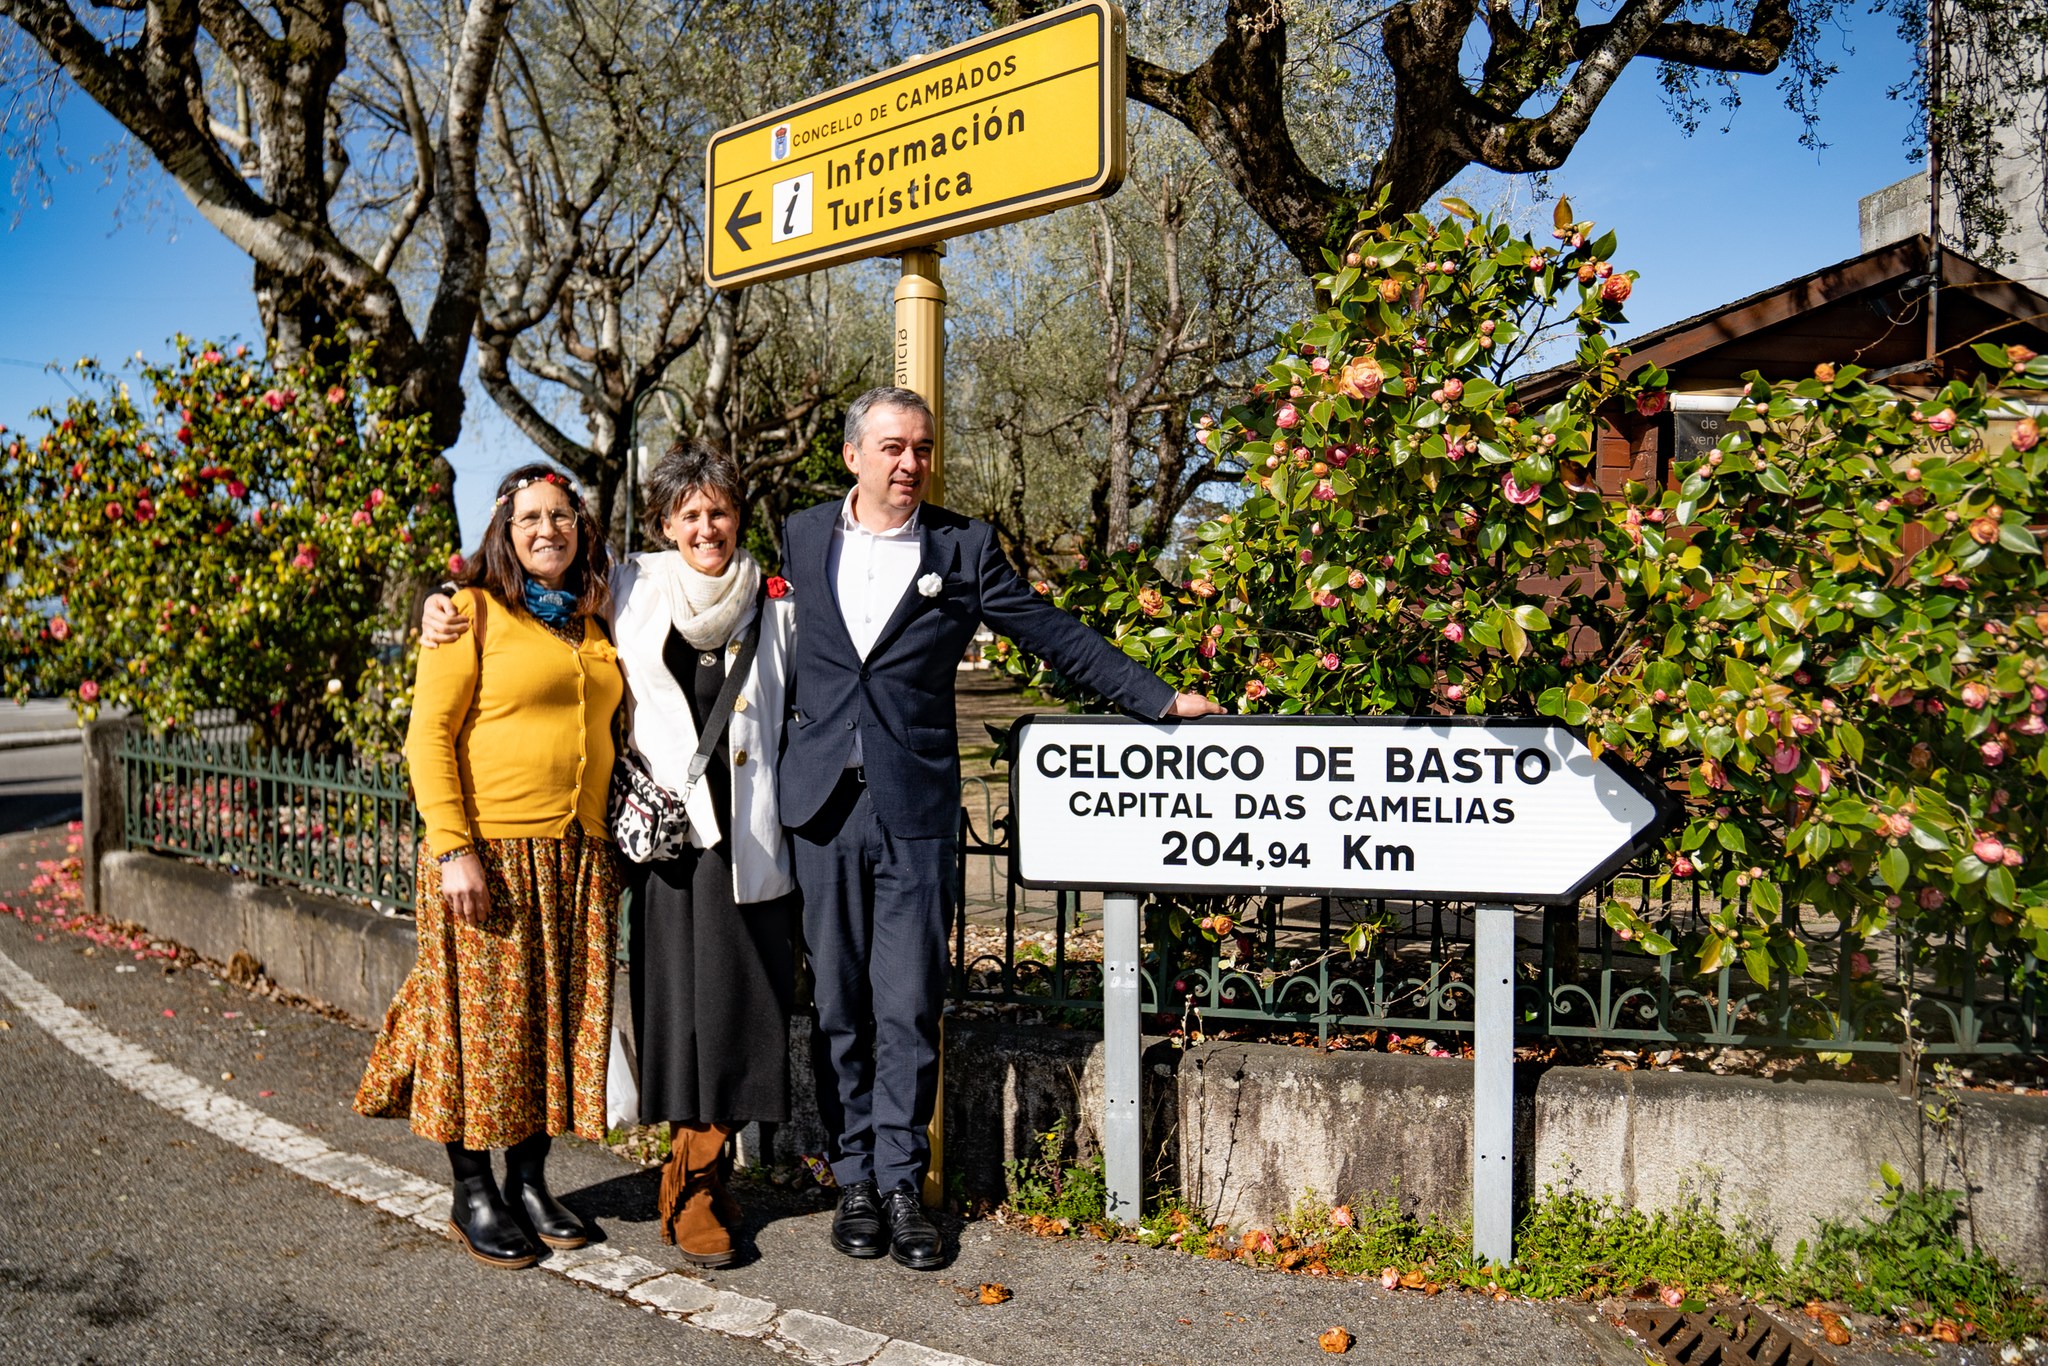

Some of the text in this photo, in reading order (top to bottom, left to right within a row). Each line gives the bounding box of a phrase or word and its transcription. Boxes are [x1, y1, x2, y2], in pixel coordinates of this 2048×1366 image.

[792, 55, 1017, 147] CONCELLO DE CAMBADOS
[827, 105, 1025, 189] Información
[827, 171, 973, 231] Turística
[896, 328, 908, 386] alicia
[1691, 434, 1720, 446] vent
[1701, 416, 1718, 430] de
[1036, 743, 1551, 785] CELORICO DE BASTO
[1069, 790, 1515, 824] CAPITAL DAS CAMELIAS
[1161, 830, 1415, 872] 204,94 Km
